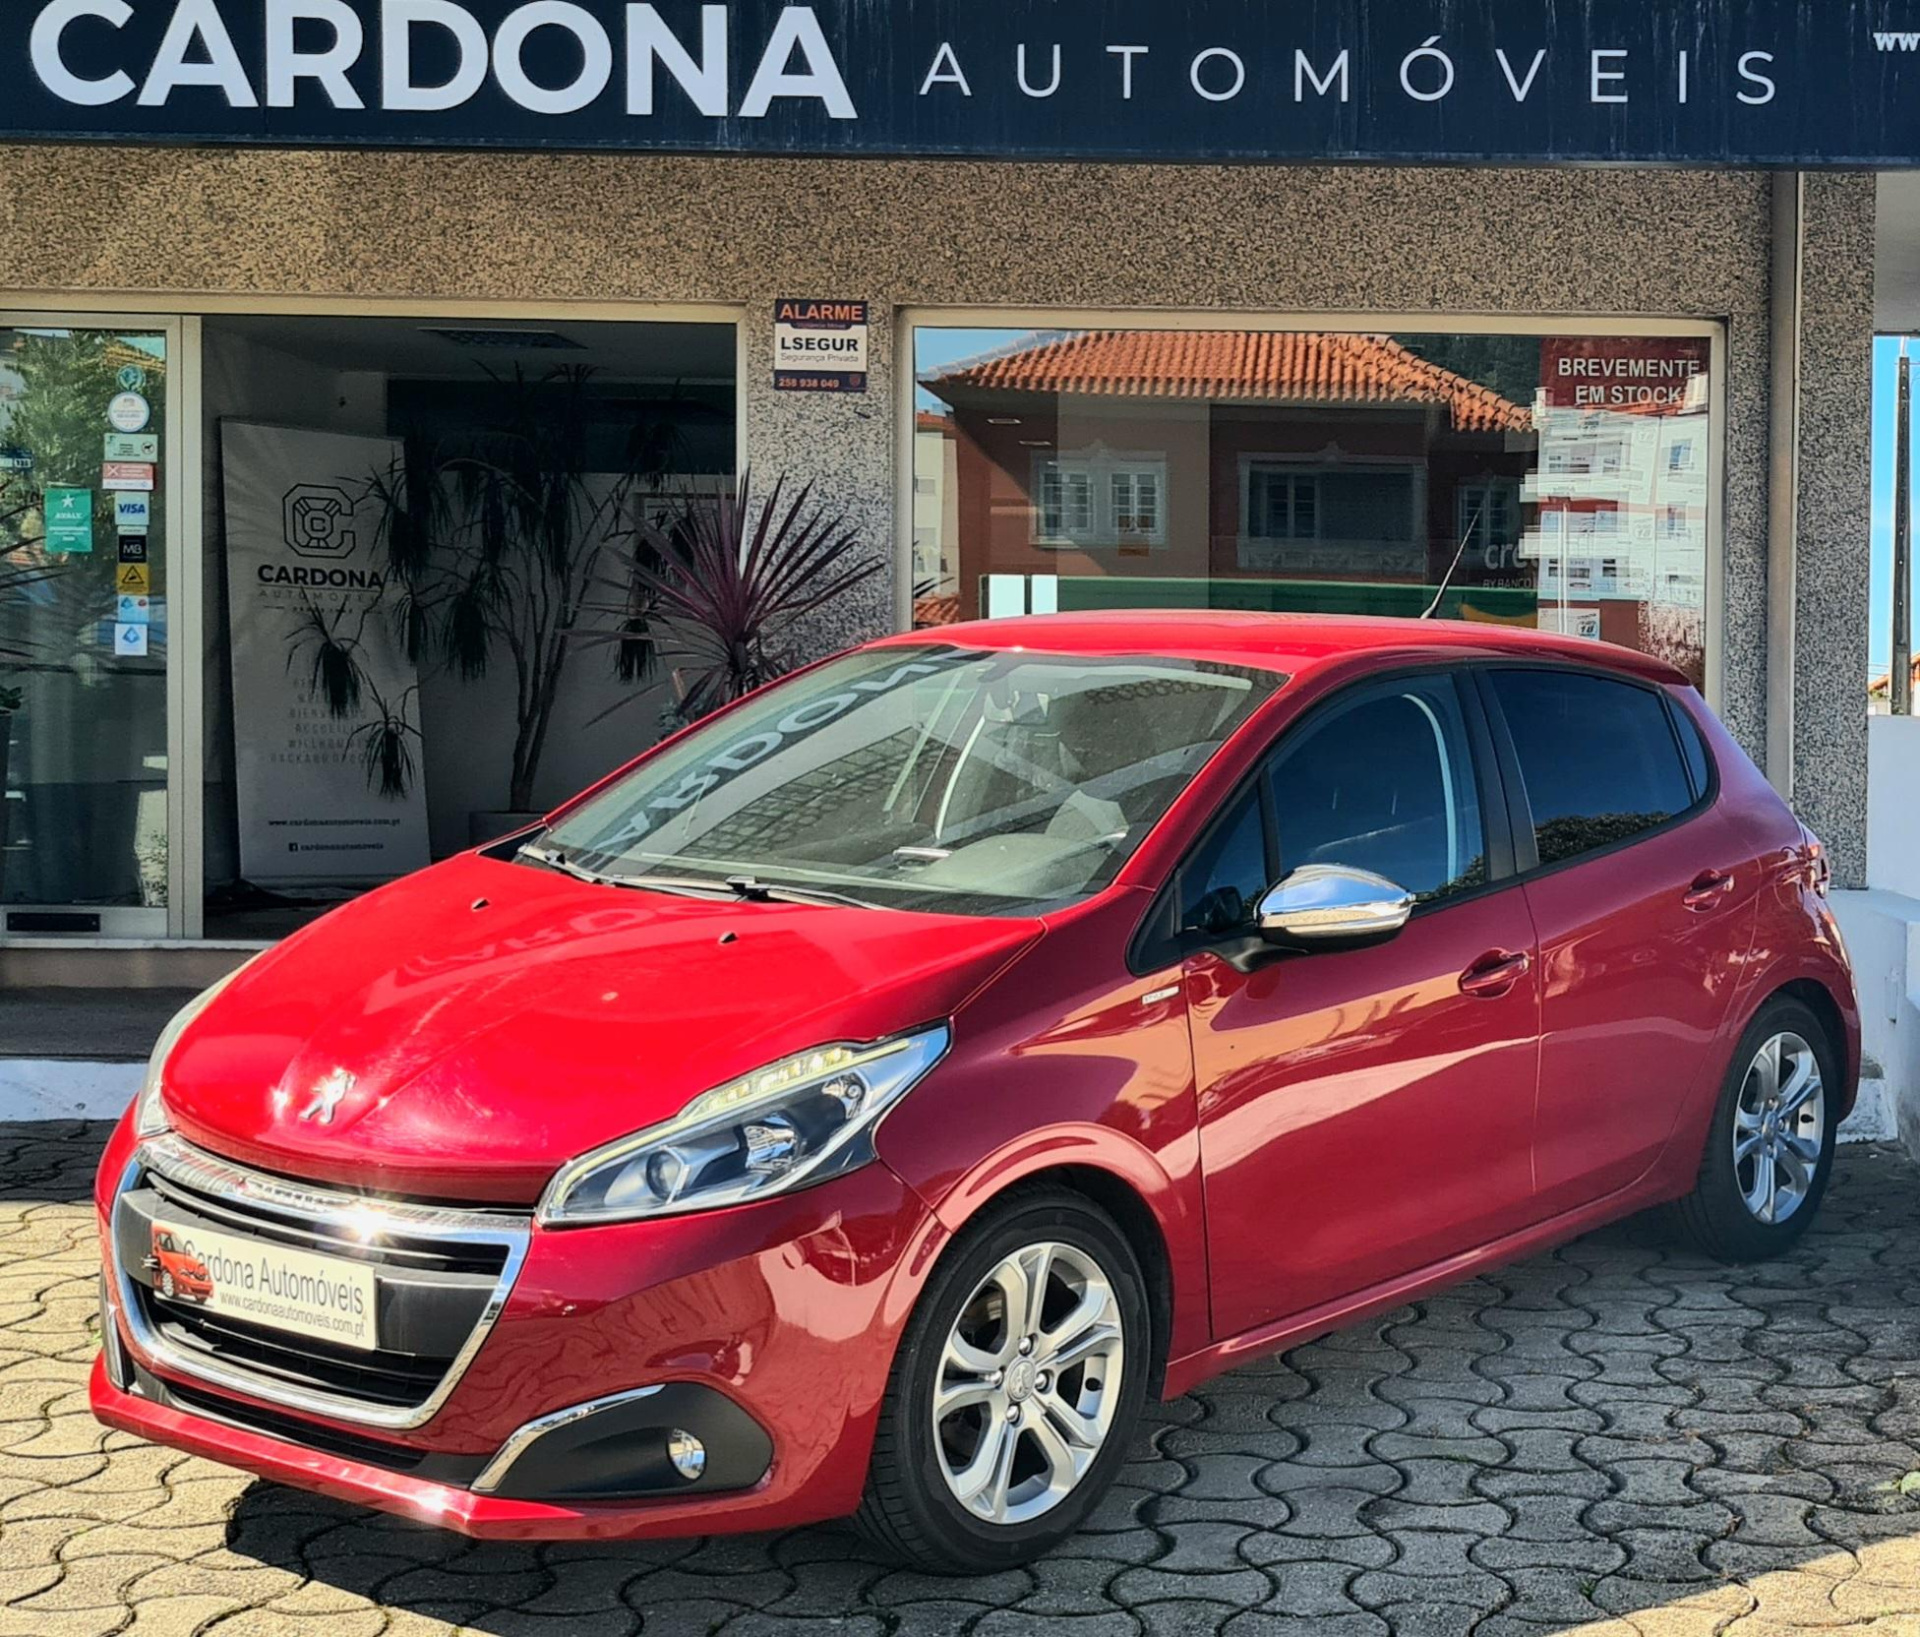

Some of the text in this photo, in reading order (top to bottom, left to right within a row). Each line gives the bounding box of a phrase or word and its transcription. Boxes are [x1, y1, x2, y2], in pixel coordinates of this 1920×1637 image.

[1872, 31, 1920, 52] ww
[29, 0, 1777, 119] CARDONA AUTOMÓVEIS
[779, 303, 864, 321] ALARME
[780, 336, 859, 352] LSEGUR
[1558, 357, 1700, 378] BREVEMENTE
[1575, 385, 1684, 405] EM STOCK
[118, 503, 146, 514] VISA
[257, 564, 383, 589] CARDONA
[183, 1239, 364, 1316] Cardona Automóveis
